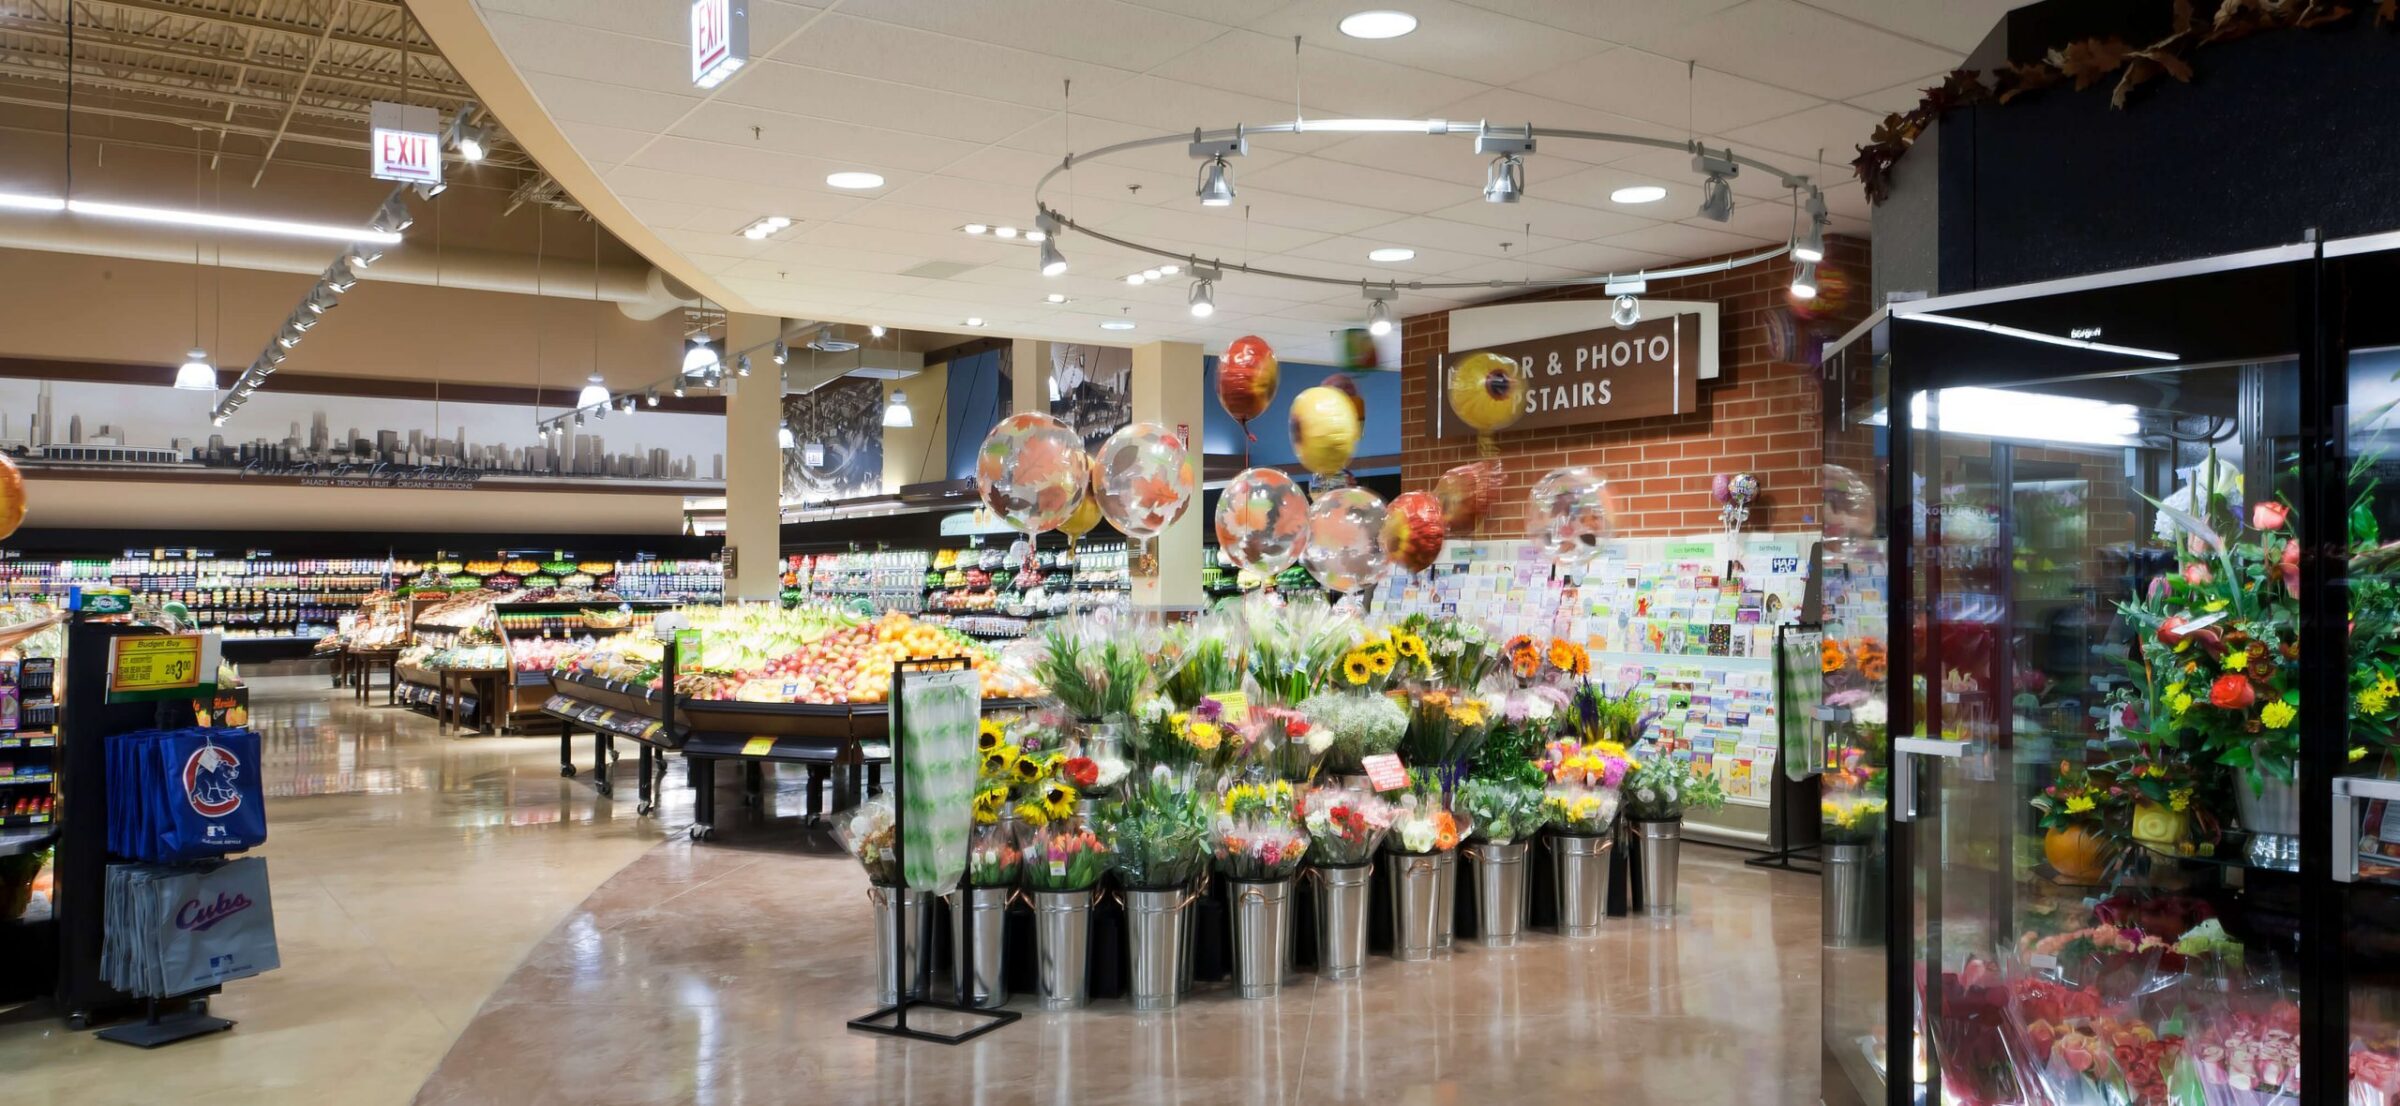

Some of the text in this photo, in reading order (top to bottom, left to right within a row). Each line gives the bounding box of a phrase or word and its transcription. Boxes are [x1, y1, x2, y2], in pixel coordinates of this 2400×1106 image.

[384, 134, 430, 168] EXIT
[1547, 351, 1562, 376] &
[1576, 335, 1670, 372] PHOTO
[1511, 379, 1612, 415] PSTAIRS
[137, 640, 165, 648] Budget
[176, 892, 252, 931] Cubs
